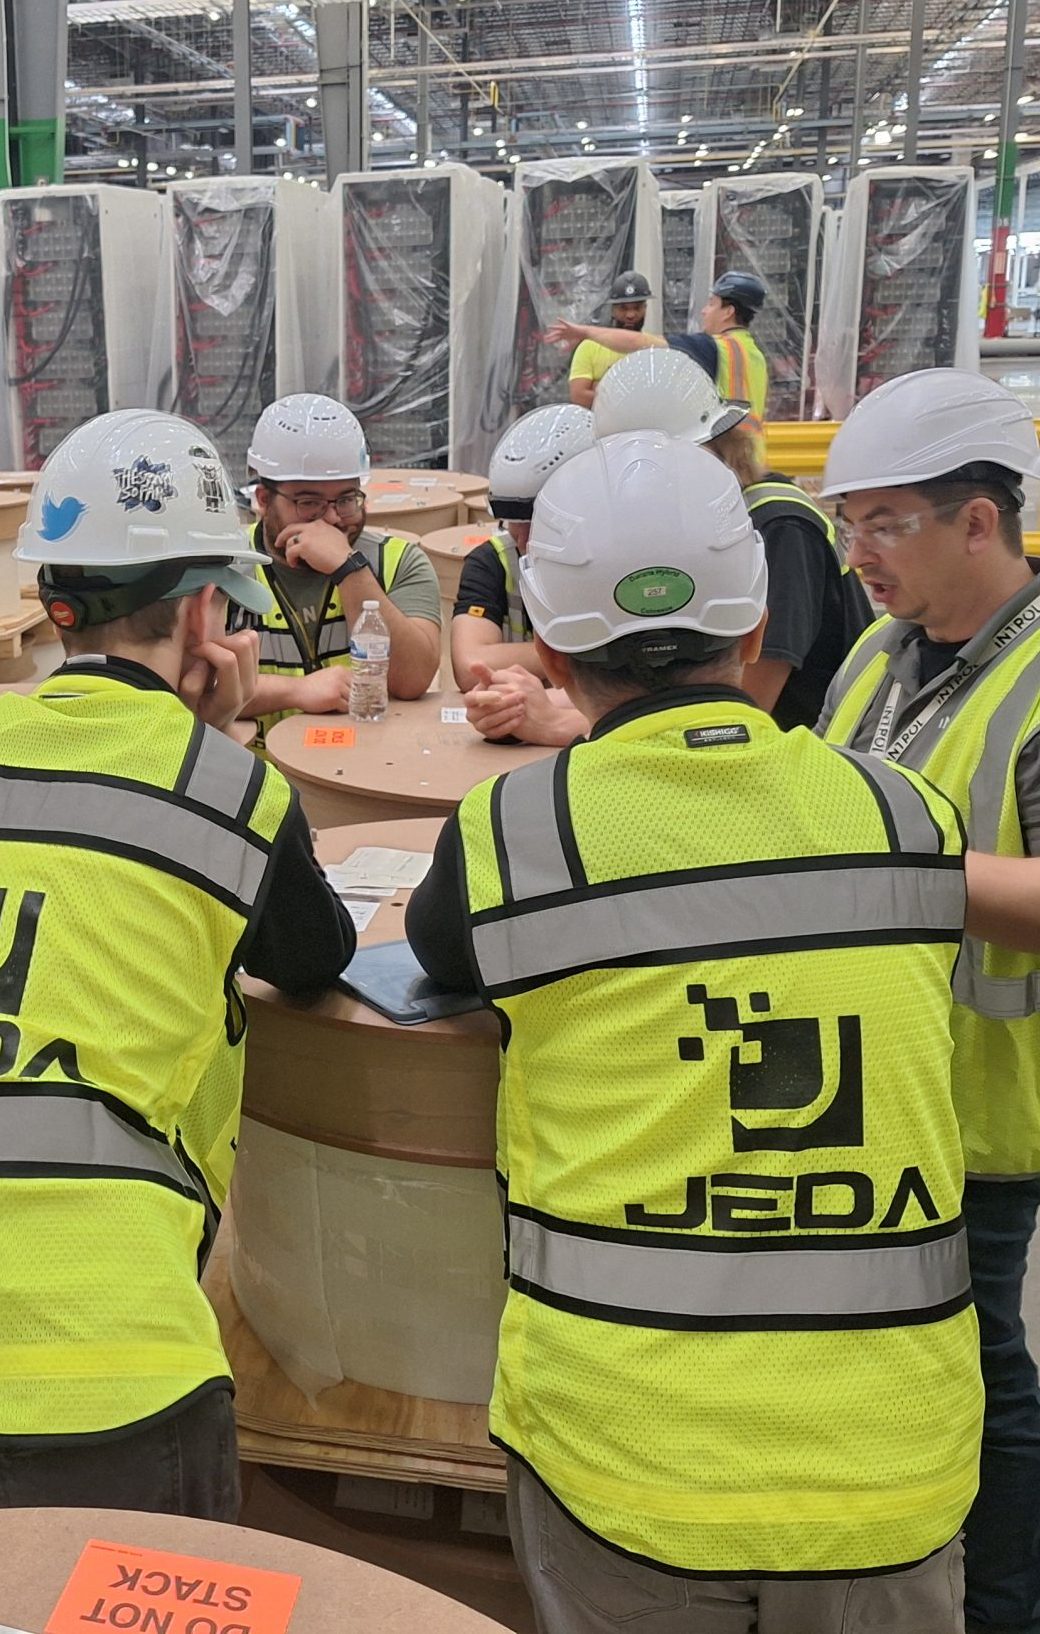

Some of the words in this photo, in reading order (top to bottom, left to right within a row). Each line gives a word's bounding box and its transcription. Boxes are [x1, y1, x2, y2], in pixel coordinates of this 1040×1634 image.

[624, 1166, 941, 1232] JEDA
[108, 1564, 252, 1612] STACK
[79, 1598, 175, 1634] NOT
